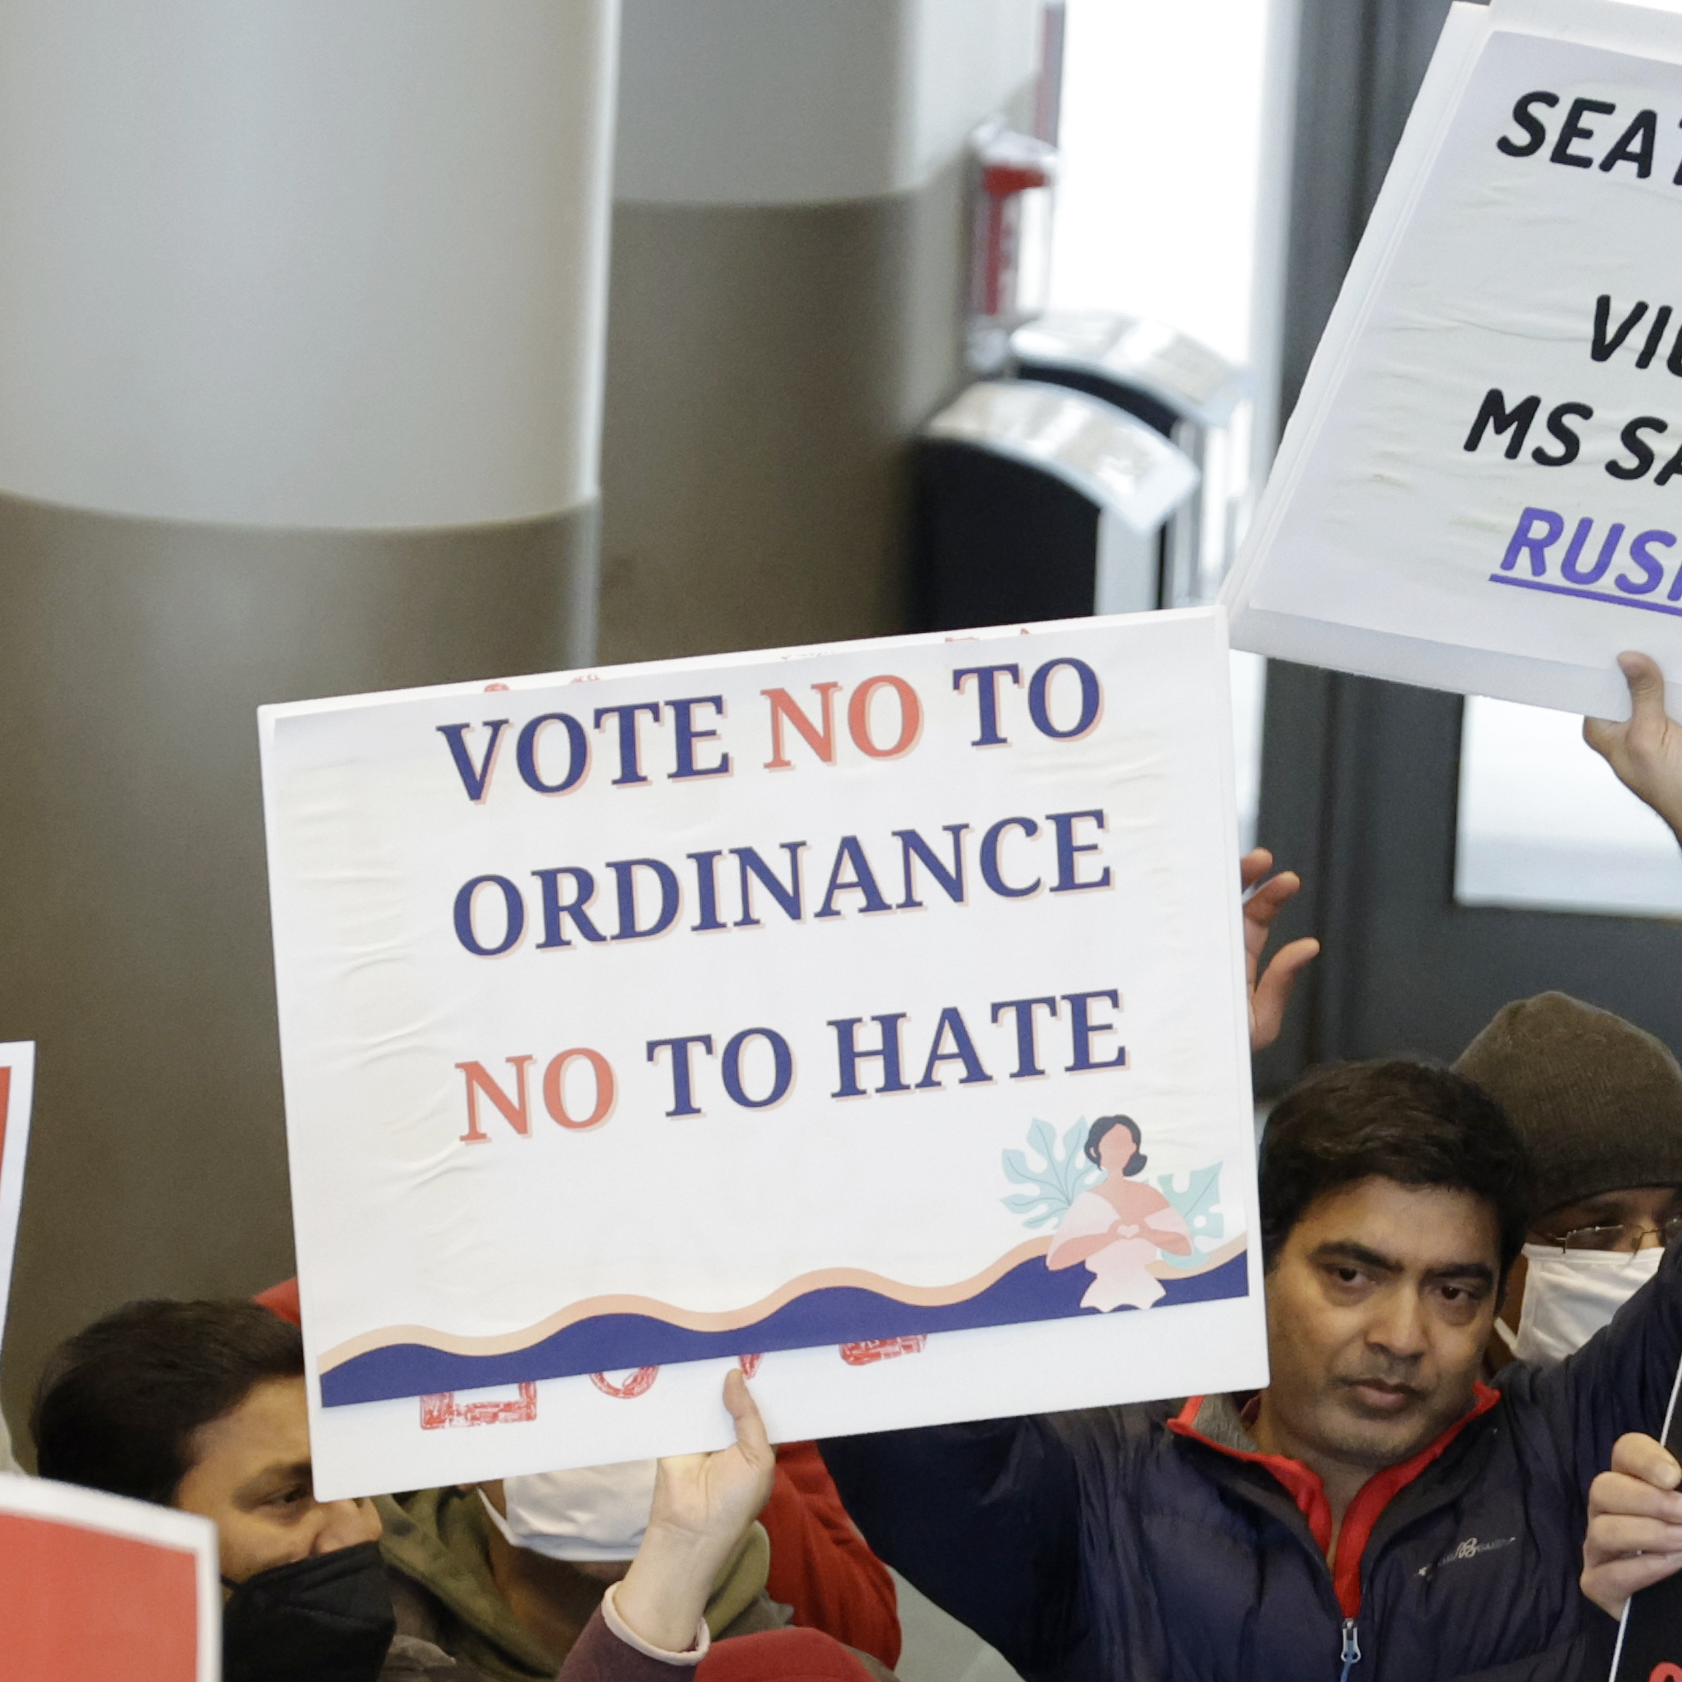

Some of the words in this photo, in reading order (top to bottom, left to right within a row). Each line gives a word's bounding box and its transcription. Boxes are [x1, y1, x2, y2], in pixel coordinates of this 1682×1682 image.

[1464, 389, 1595, 466] MS
[437, 694, 732, 803] VOTE
[762, 673, 921, 771] NO
[952, 656, 1103, 748] TO
[452, 808, 1114, 959] ORDINANCE
[456, 1046, 618, 1145] NO
[646, 1025, 795, 1119] TO
[826, 987, 1129, 1101] HATE
